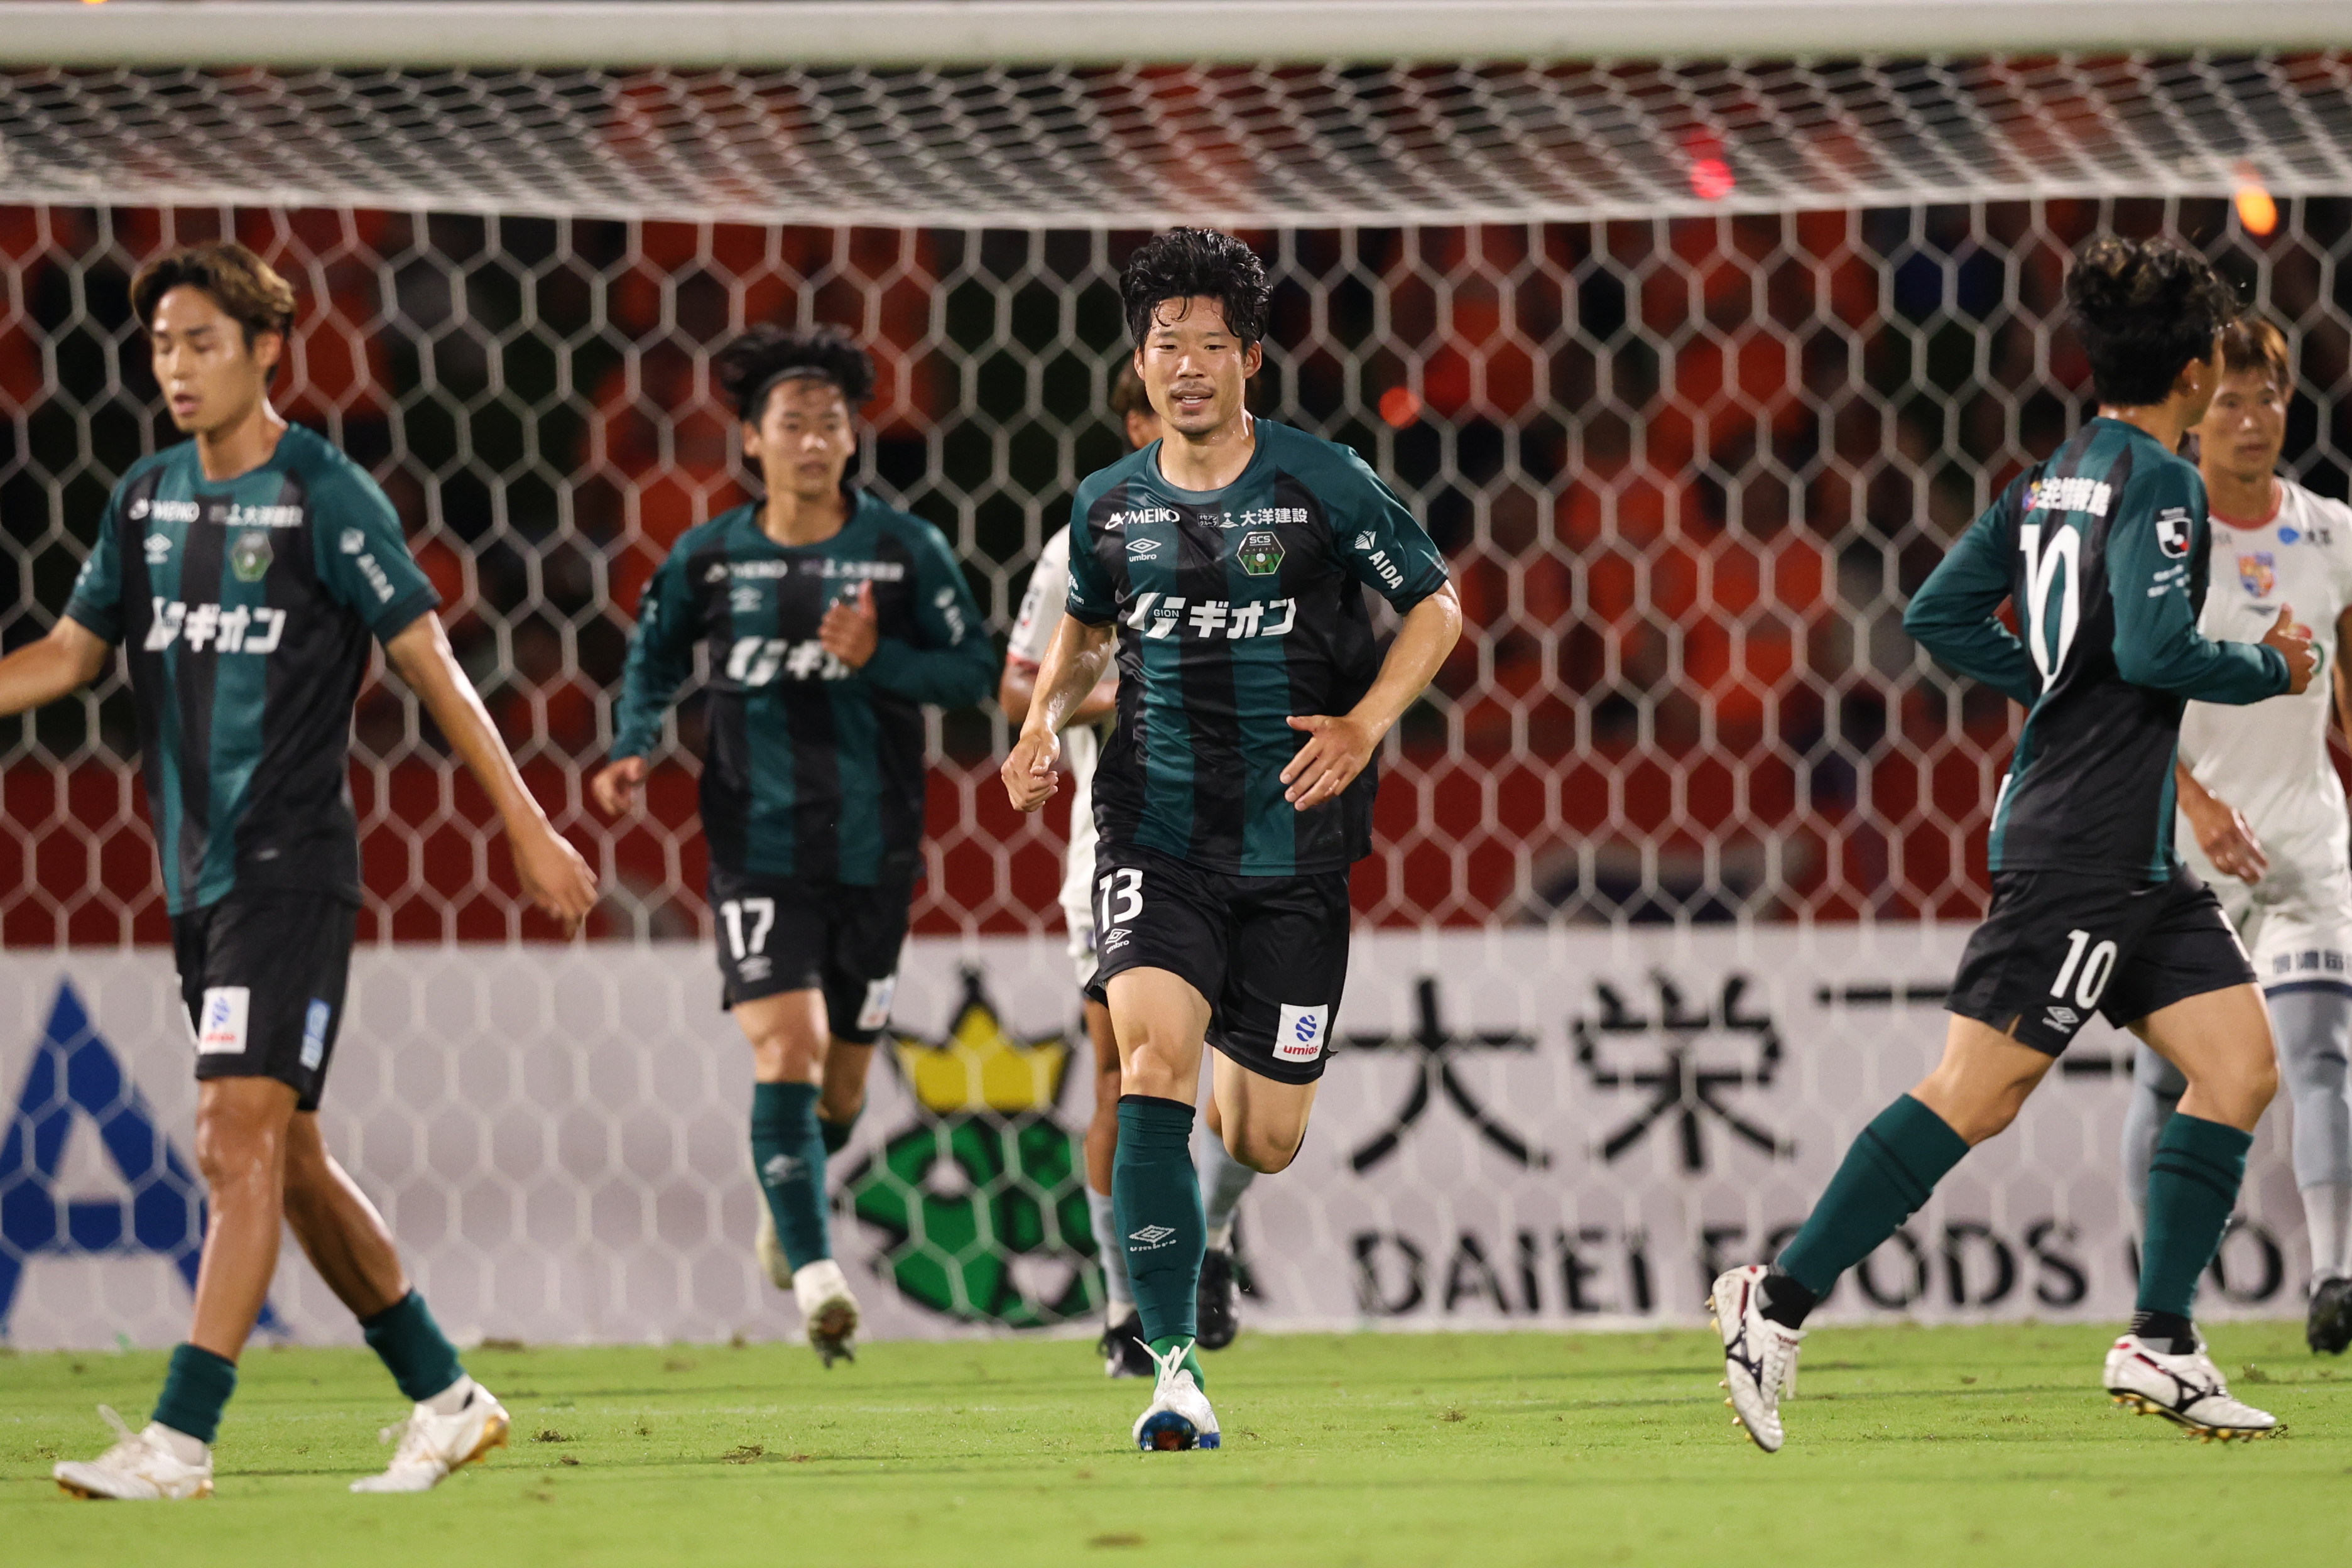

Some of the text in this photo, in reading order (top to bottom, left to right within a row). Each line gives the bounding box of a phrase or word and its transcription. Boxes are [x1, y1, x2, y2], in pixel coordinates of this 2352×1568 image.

[1128, 508, 1180, 524] MEIKO
[1240, 508, 1308, 527] 大洋建設
[1249, 535, 1271, 544] SCS
[1129, 553, 1157, 562] umbro
[1368, 550, 1403, 589] AIDA
[1153, 609, 1180, 618] GION
[1189, 597, 1297, 640] ギオン
[2019, 524, 2080, 694] 10
[183, 603, 287, 655] ギオン
[1099, 868, 1143, 934] 13
[721, 897, 775, 961] 17
[1106, 940, 1130, 954] umbro
[2049, 929, 2118, 1010] 10
[1283, 1044, 1319, 1055] umios
[1130, 1239, 1177, 1252] umbro
[1351, 1228, 1655, 1314] DAIEI
[1699, 1221, 2087, 1309] FODS
